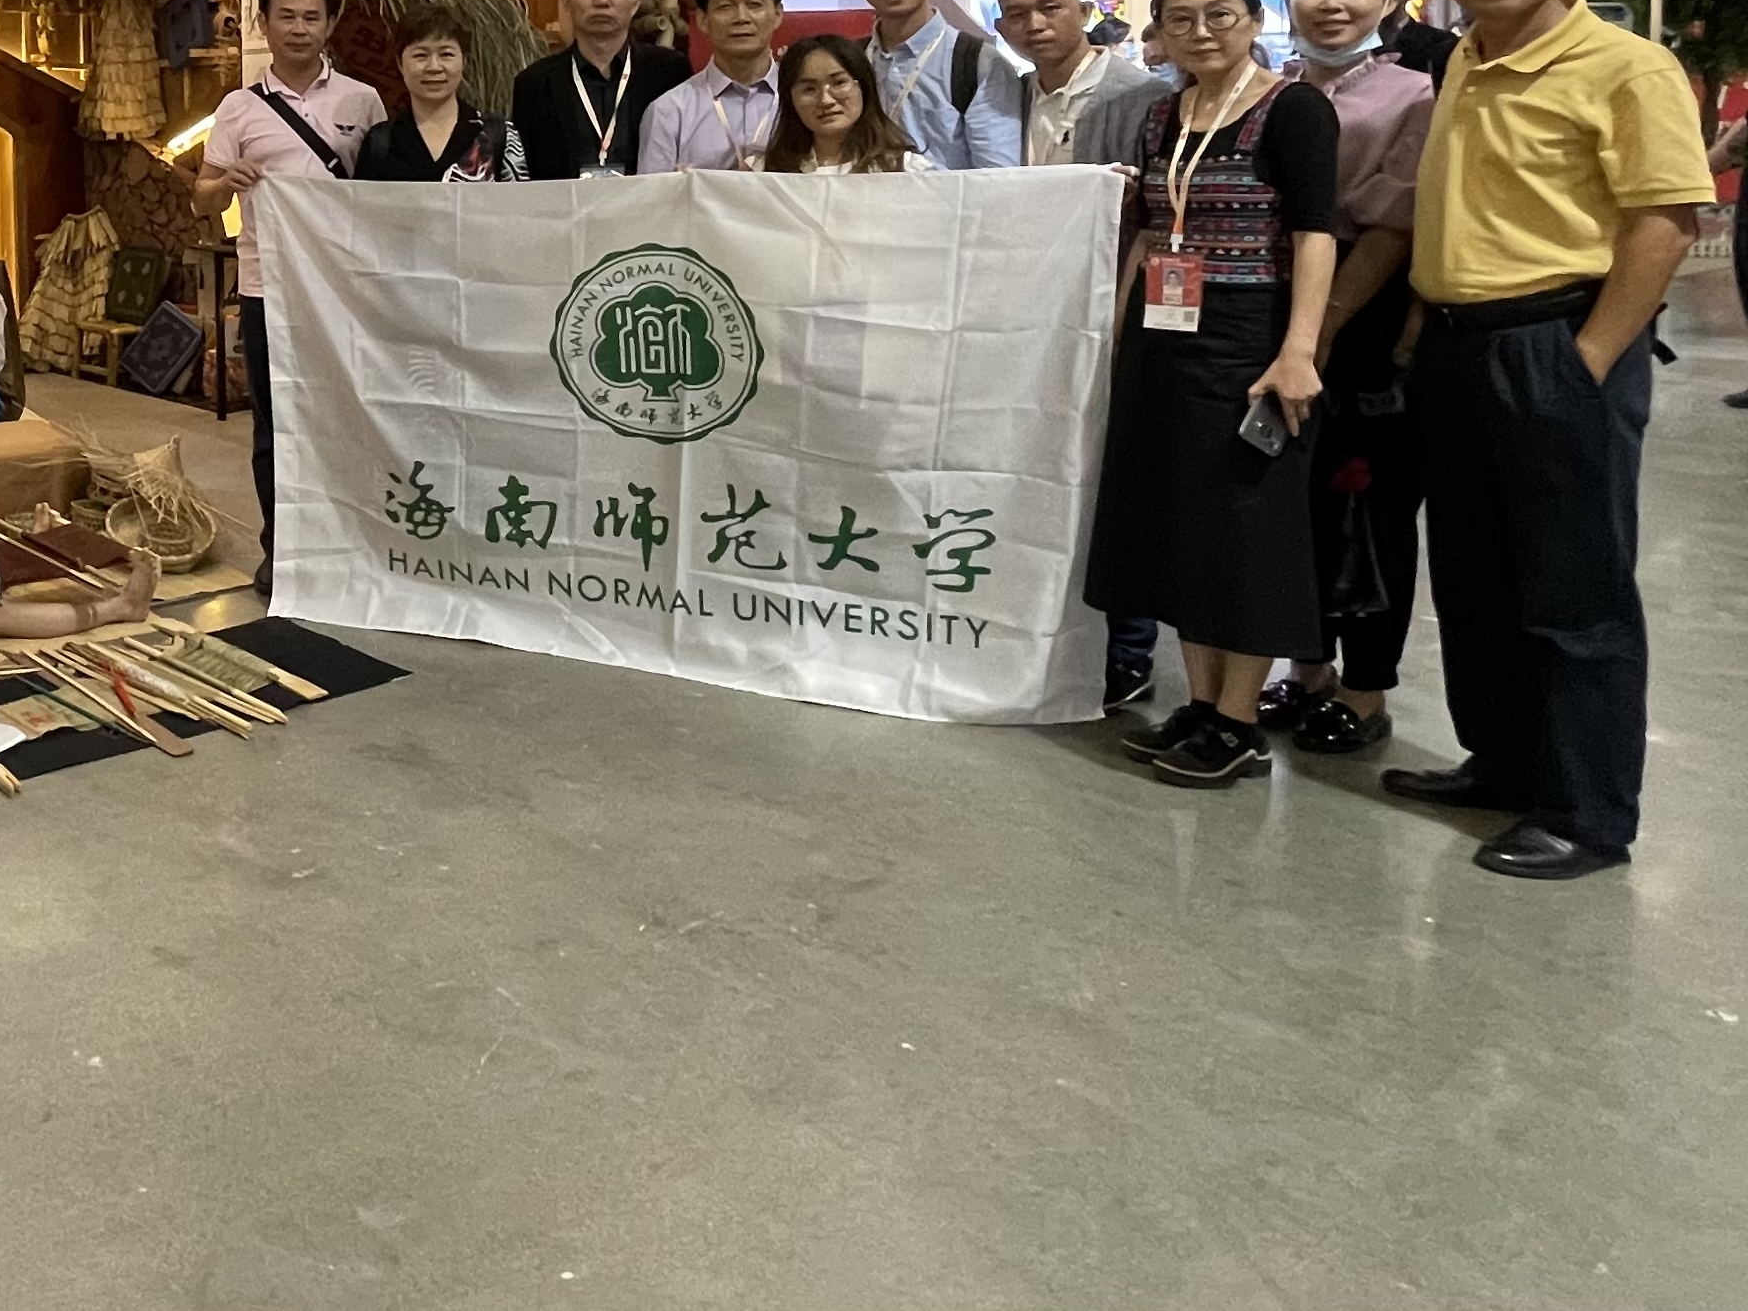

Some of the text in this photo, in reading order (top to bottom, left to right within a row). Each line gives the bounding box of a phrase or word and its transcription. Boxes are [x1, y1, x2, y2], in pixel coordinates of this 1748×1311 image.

[569, 262, 745, 363] HAINAN NORMAL UNIVERSITY
[385, 460, 997, 593] 海南师范大学
[388, 548, 989, 649] HAINAN NORMAL UNIVERSITY
